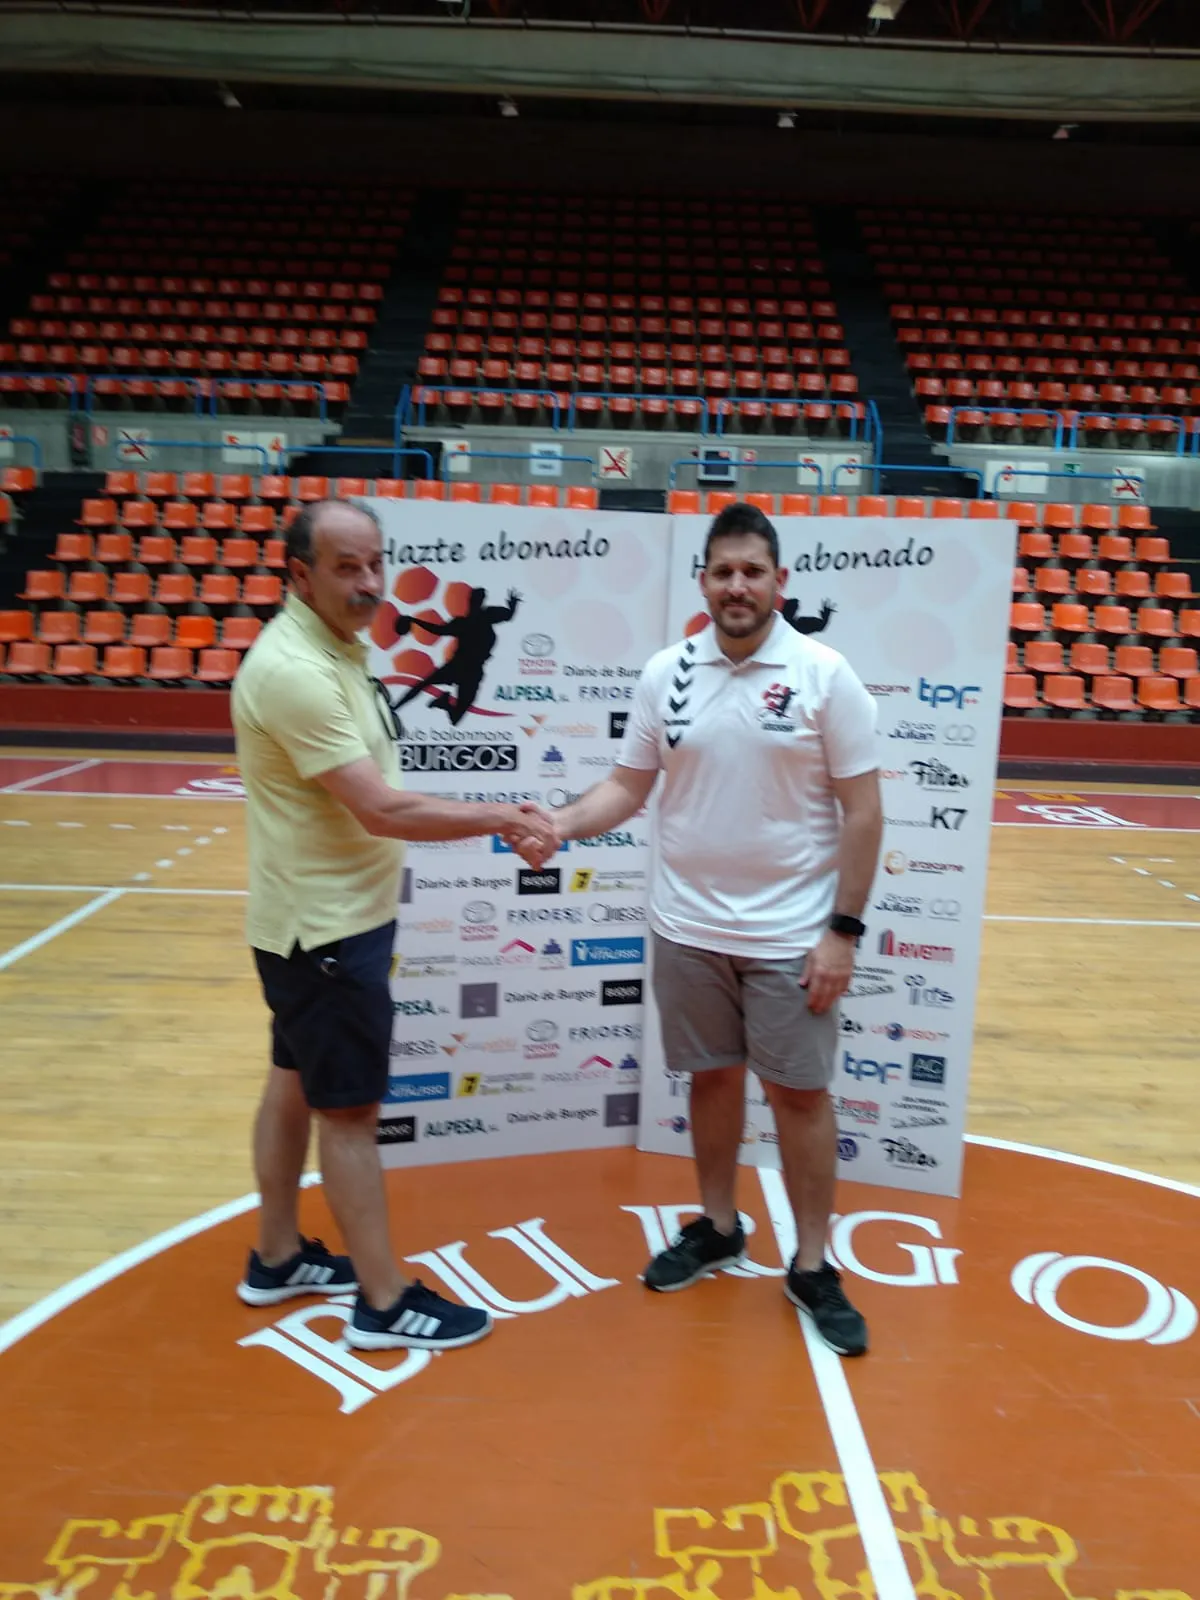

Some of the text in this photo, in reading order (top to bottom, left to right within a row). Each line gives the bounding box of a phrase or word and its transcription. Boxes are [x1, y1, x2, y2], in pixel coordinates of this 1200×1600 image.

[380, 529, 611, 565] Hazte abonado
[794, 538, 935, 572] abonado
[563, 665, 599, 678] Diario
[601, 665, 615, 677] de
[617, 666, 643, 680] Burg
[494, 685, 555, 702] ALPESA
[919, 677, 981, 709] tpr
[397, 727, 428, 743] lub
[399, 746, 516, 771] BURGOS
[930, 806, 969, 830] K7
[416, 878, 451, 890] Diario
[452, 876, 468, 888] de
[471, 876, 513, 890] Burgos
[504, 991, 538, 1003] Diario
[558, 989, 598, 1002] Burgos
[391, 1000, 438, 1016] PESA
[507, 1110, 541, 1124] Diario
[559, 1107, 599, 1121] Burgos
[424, 1119, 487, 1137] ALPESA
